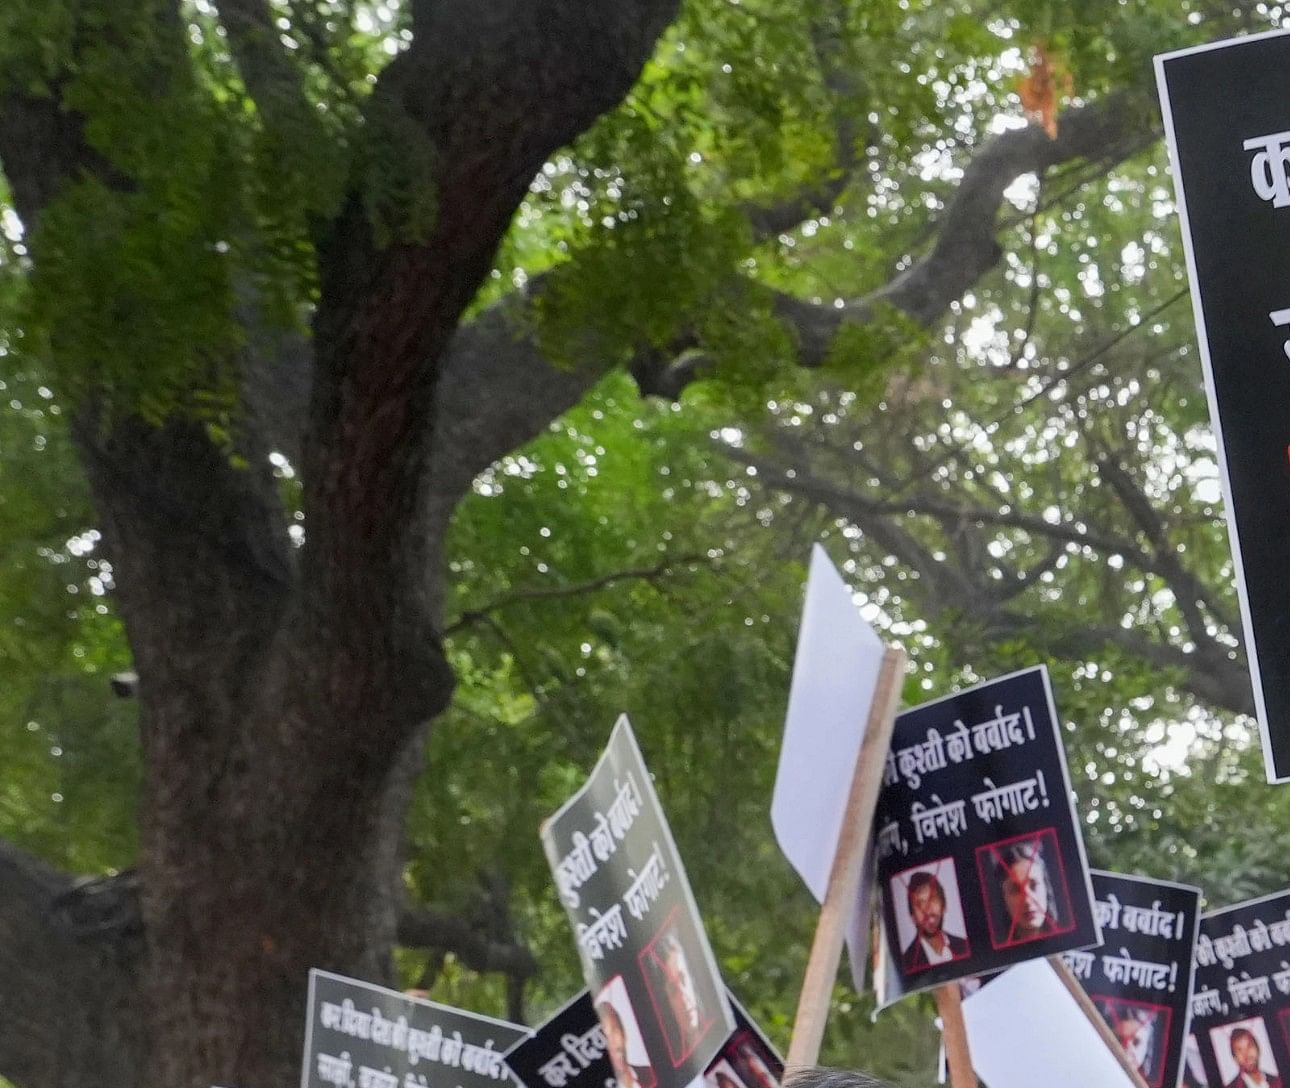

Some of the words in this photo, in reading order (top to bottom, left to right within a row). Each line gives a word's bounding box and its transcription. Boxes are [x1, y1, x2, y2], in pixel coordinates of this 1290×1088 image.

[897, 728, 947, 790] कुश्ती
[945, 719, 974, 763] को
[911, 794, 968, 844] विनेश
[971, 769, 1050, 824] फोगाट!
[1102, 946, 1178, 993] फोगाट!
[537, 1051, 580, 1088] कर
